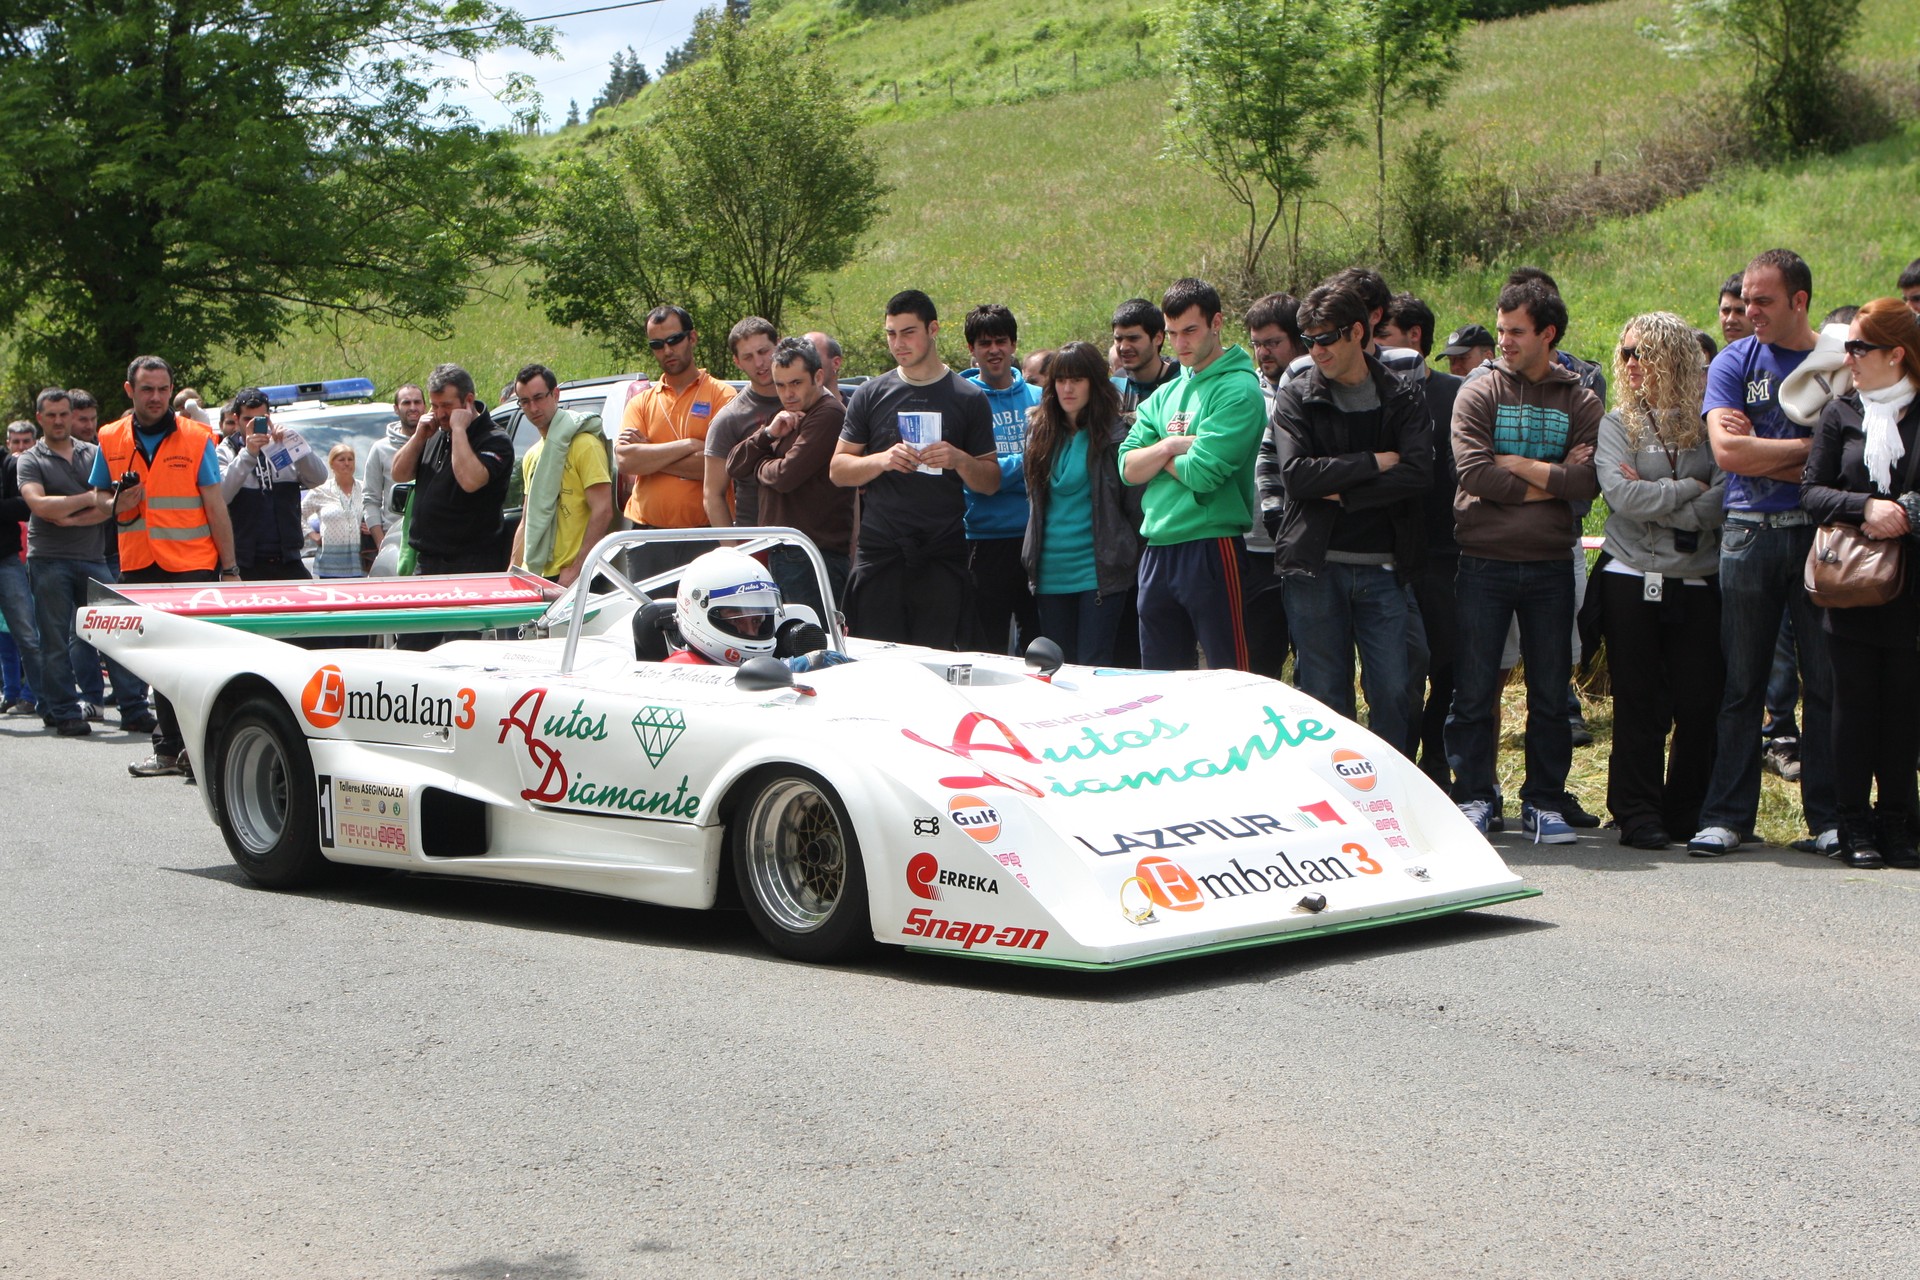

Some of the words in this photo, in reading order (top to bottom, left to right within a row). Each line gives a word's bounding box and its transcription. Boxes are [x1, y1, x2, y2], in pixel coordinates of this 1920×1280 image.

[1747, 378, 1770, 403] M
[184, 588, 296, 610] Autos
[298, 586, 484, 604] Diamante
[83, 610, 143, 634] Snap-on
[498, 687, 609, 744] Autos
[901, 711, 1189, 765] Autos
[521, 739, 701, 818] Diamante
[1336, 762, 1373, 776] Gulf
[339, 781, 360, 794] Talleres
[361, 784, 404, 798] ASEGINOLAZA
[952, 810, 998, 826] Gulf
[1073, 813, 1297, 857] LAZPIUR
[939, 869, 999, 895] ERREKA
[901, 907, 1049, 950] Snap-on
